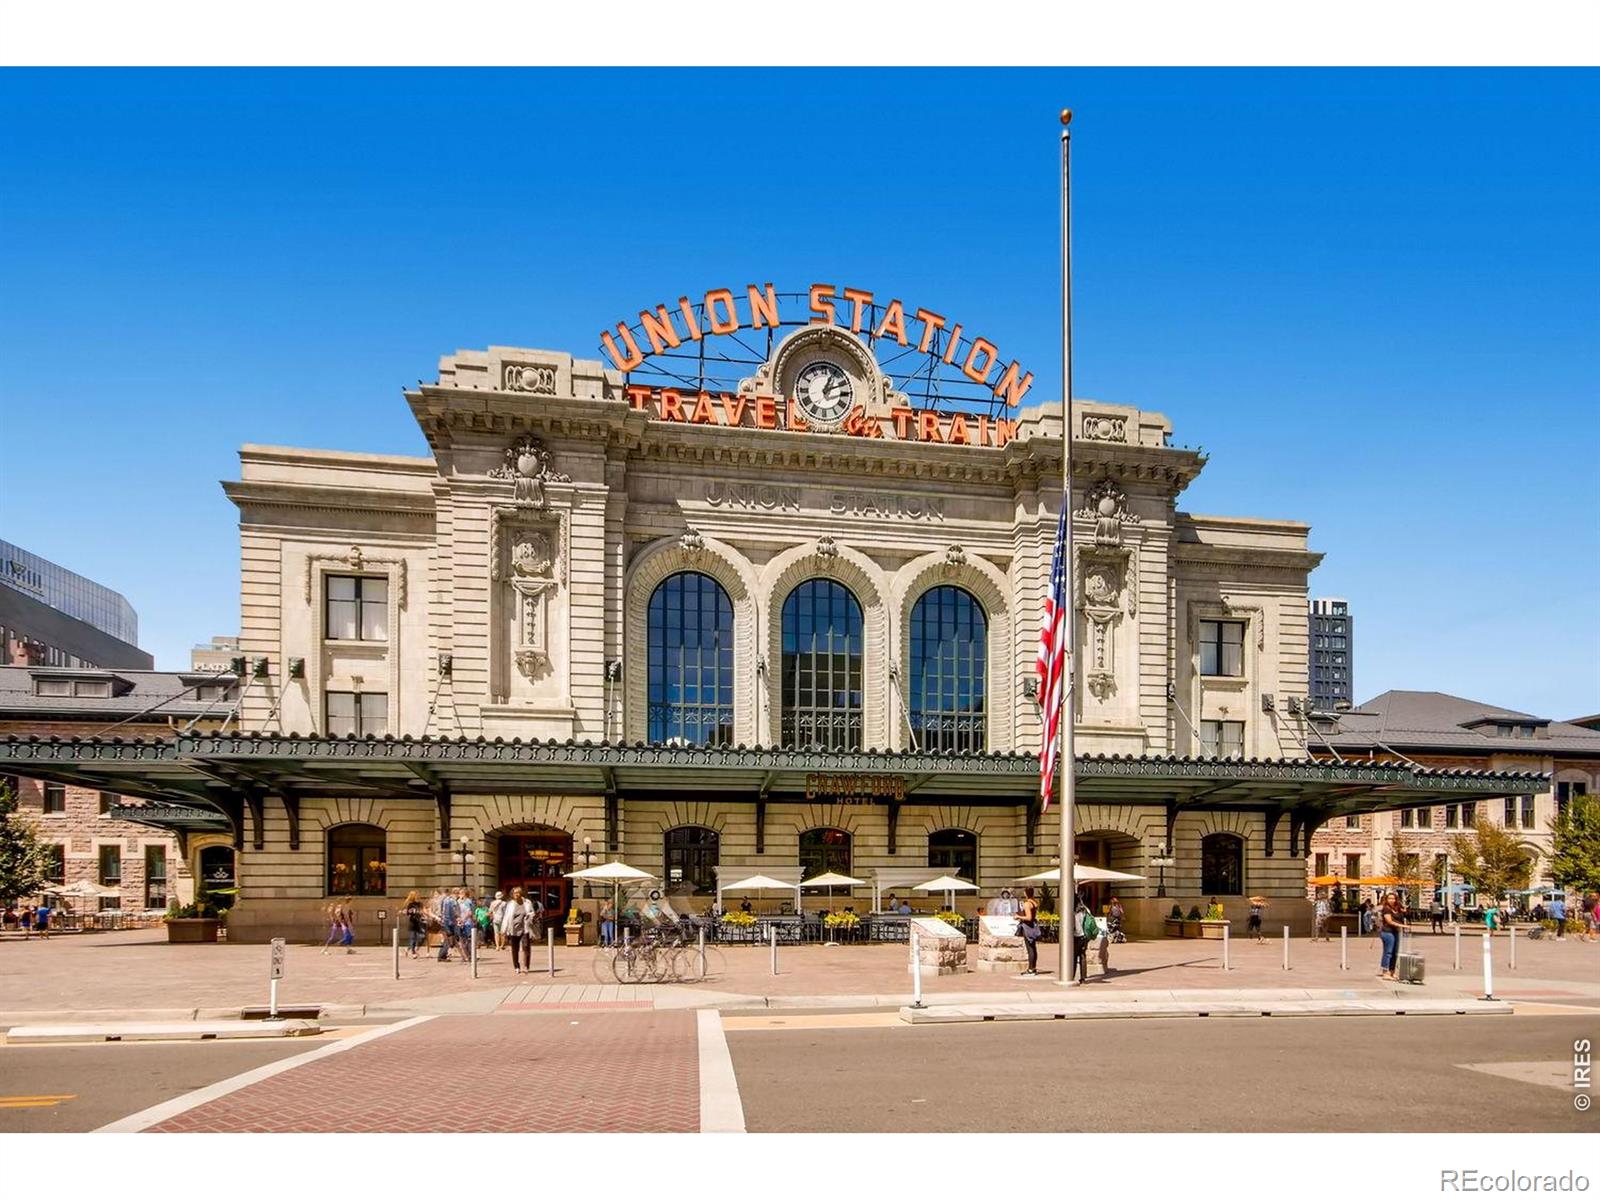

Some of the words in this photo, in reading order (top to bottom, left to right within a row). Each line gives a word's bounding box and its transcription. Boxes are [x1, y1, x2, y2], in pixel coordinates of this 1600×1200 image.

[600, 282, 780, 373] UNION
[808, 284, 1034, 408] STATION
[628, 386, 808, 430] TRAVEL
[891, 407, 1018, 447] TRAIN
[706, 482, 800, 511] UNION
[830, 493, 944, 521] STATION
[806, 773, 904, 800] CRAWFORD
[837, 797, 875, 805] HOTEL
